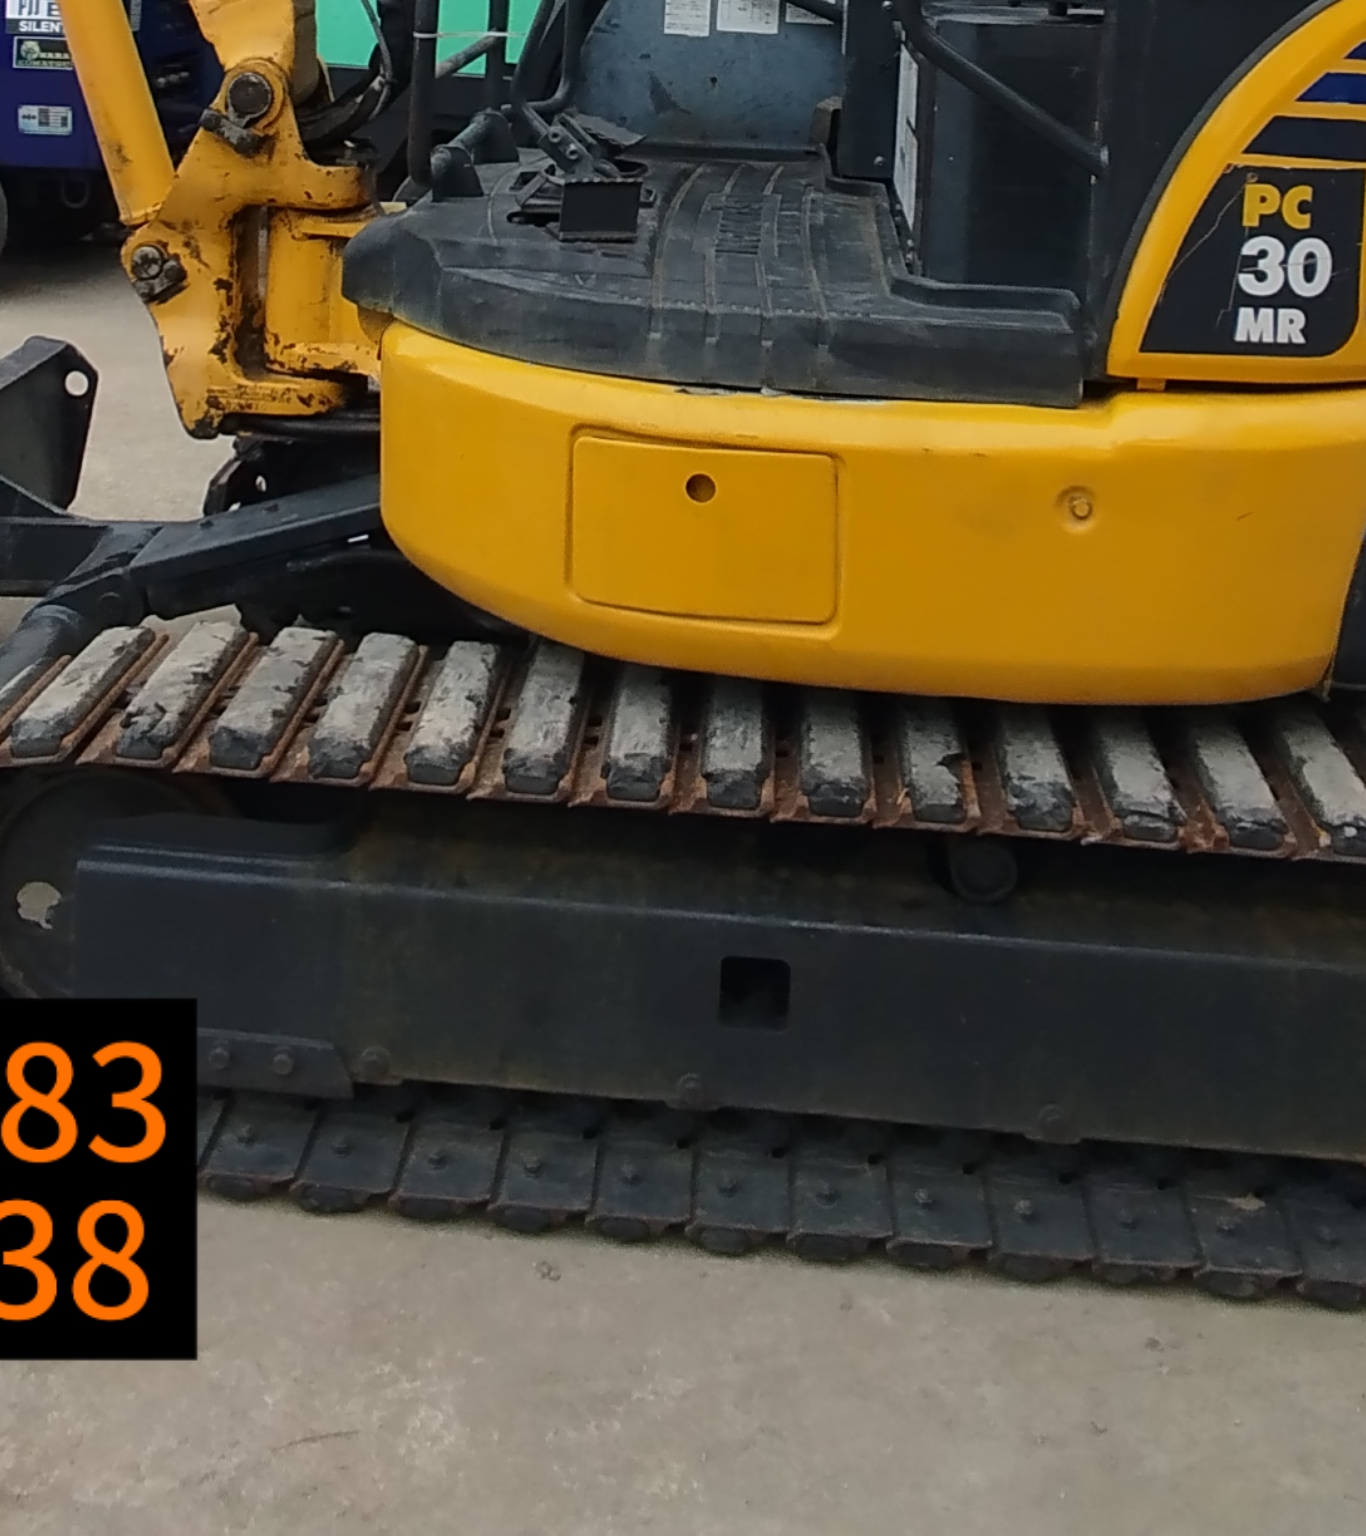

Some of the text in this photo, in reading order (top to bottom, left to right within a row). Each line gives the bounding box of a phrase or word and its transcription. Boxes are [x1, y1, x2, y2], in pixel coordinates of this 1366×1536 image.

[1242, 183, 1314, 230] PC
[1238, 235, 1333, 298] 30
[1234, 306, 1306, 344] MR
